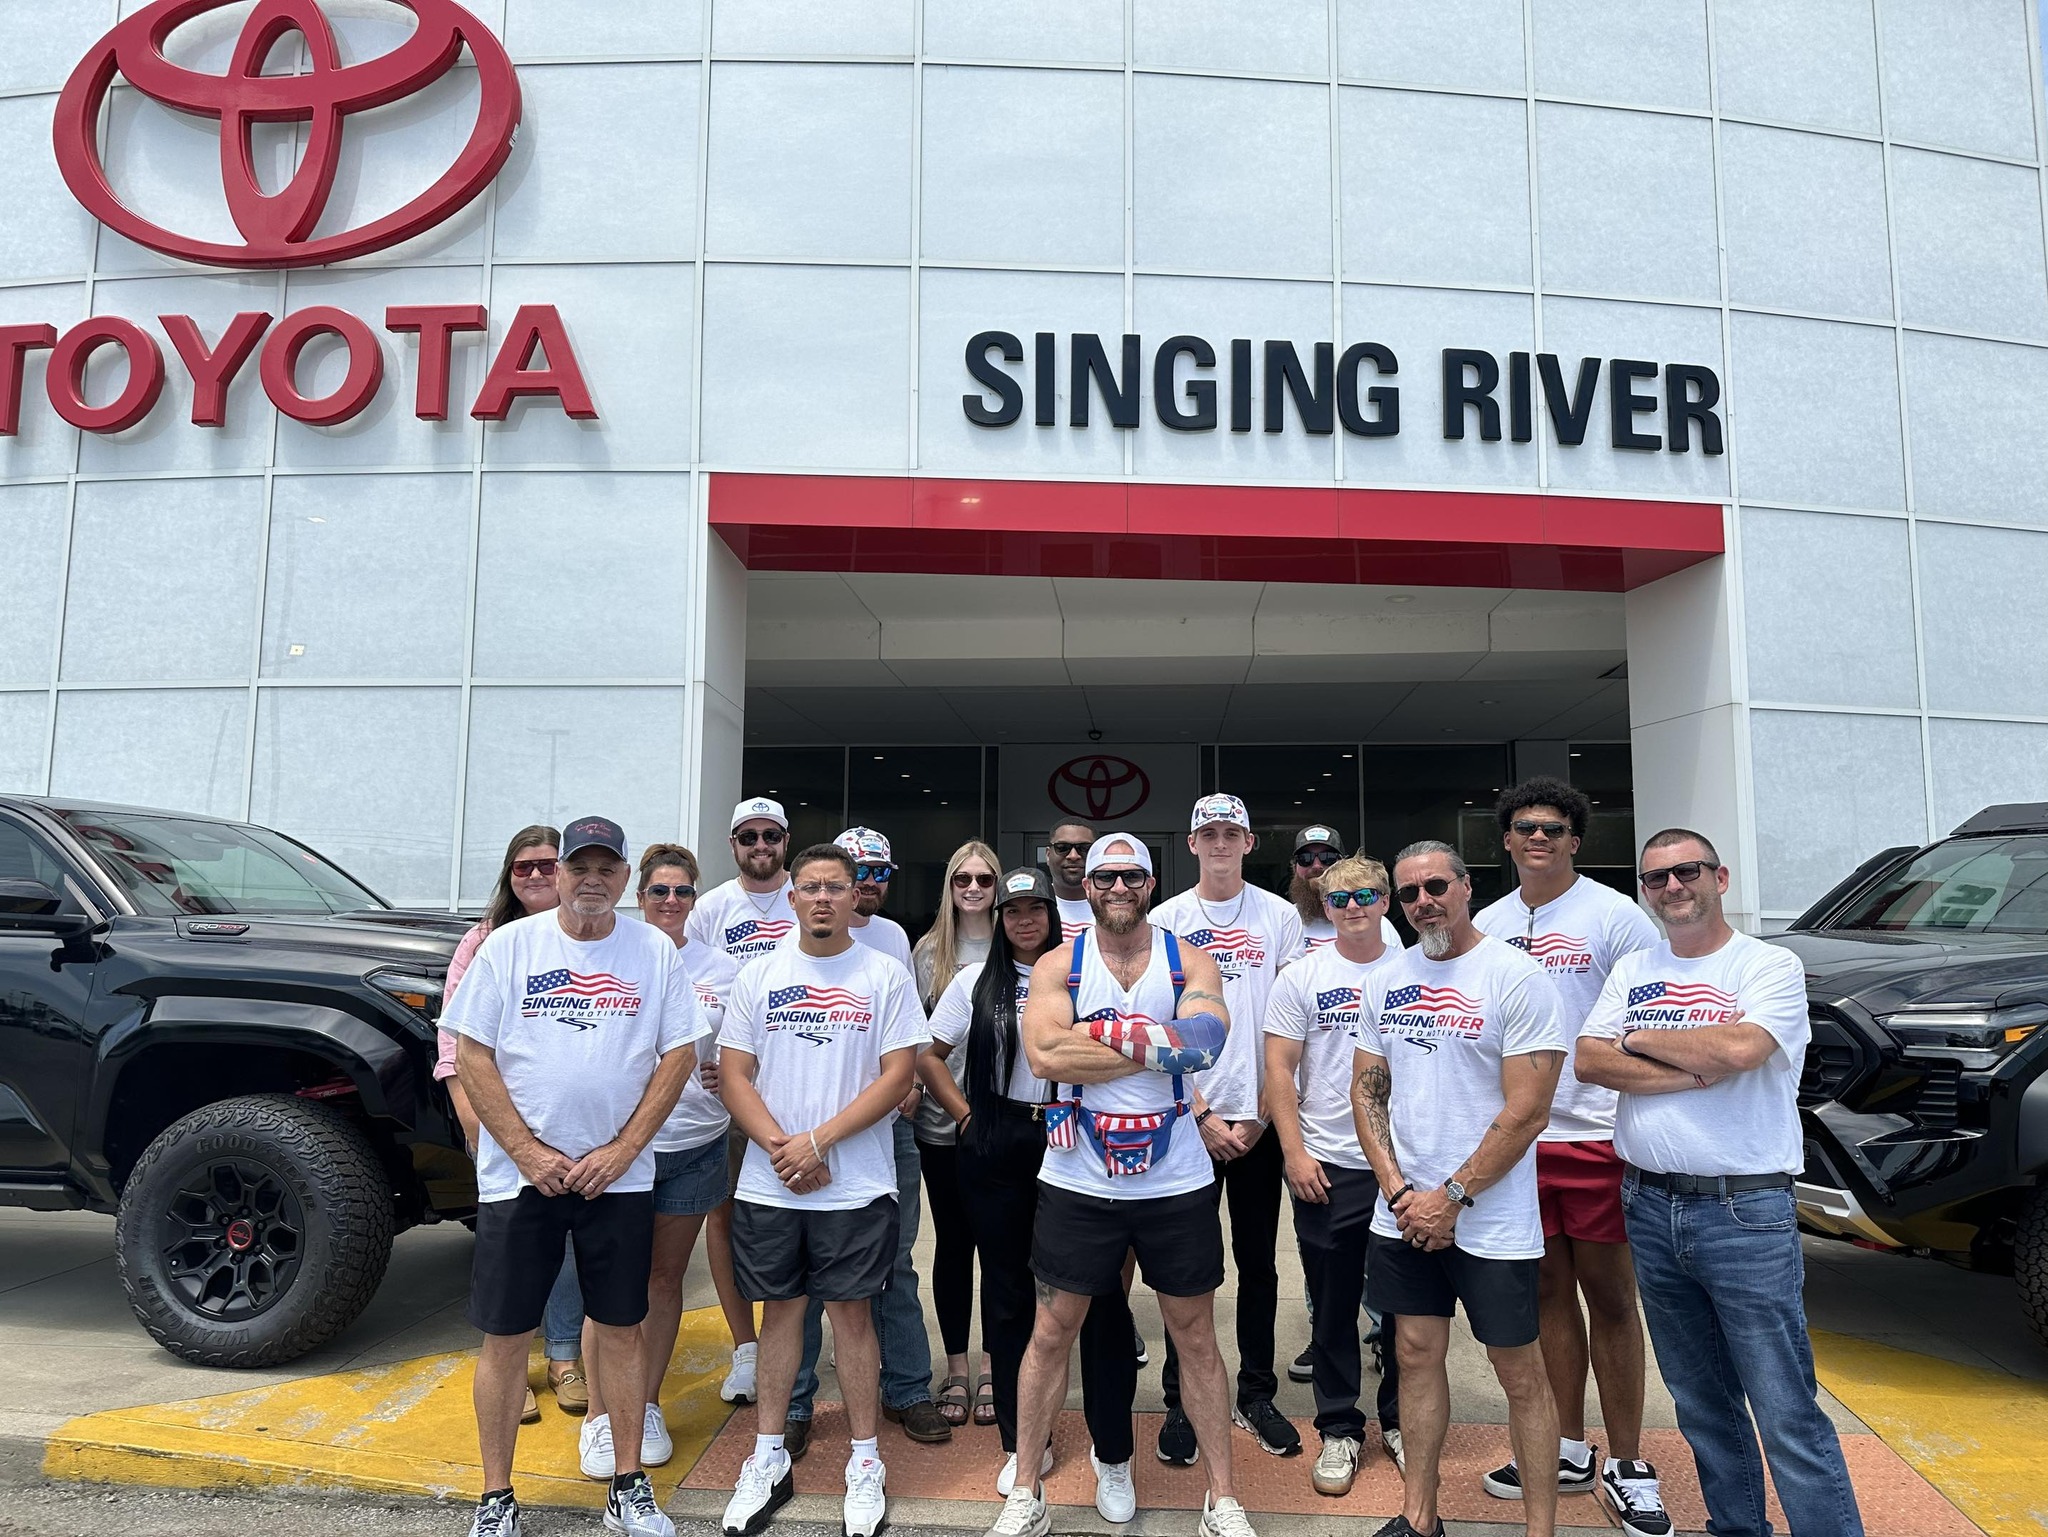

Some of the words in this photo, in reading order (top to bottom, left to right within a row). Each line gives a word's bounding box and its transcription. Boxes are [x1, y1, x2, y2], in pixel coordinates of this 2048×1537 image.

[0, 304, 599, 436] TOYOTA
[962, 330, 1400, 437] SINGING
[1442, 347, 1724, 456] RIVER
[726, 941, 776, 955] SINGING
[1545, 953, 1591, 968] RIVER
[521, 997, 591, 1010] SINGING
[594, 997, 641, 1009] RIVER
[765, 1011, 827, 1024] SINGING
[829, 1010, 872, 1024] RIVER
[1379, 1013, 1435, 1028] SINGING
[1436, 1014, 1484, 1031] RIVER
[1688, 1009, 1732, 1023] RIVE
[1390, 1028, 1461, 1037] AUTOMOTIVE
[316, 1089, 338, 1098] TRD
[138, 1274, 250, 1347] WRANGLER
